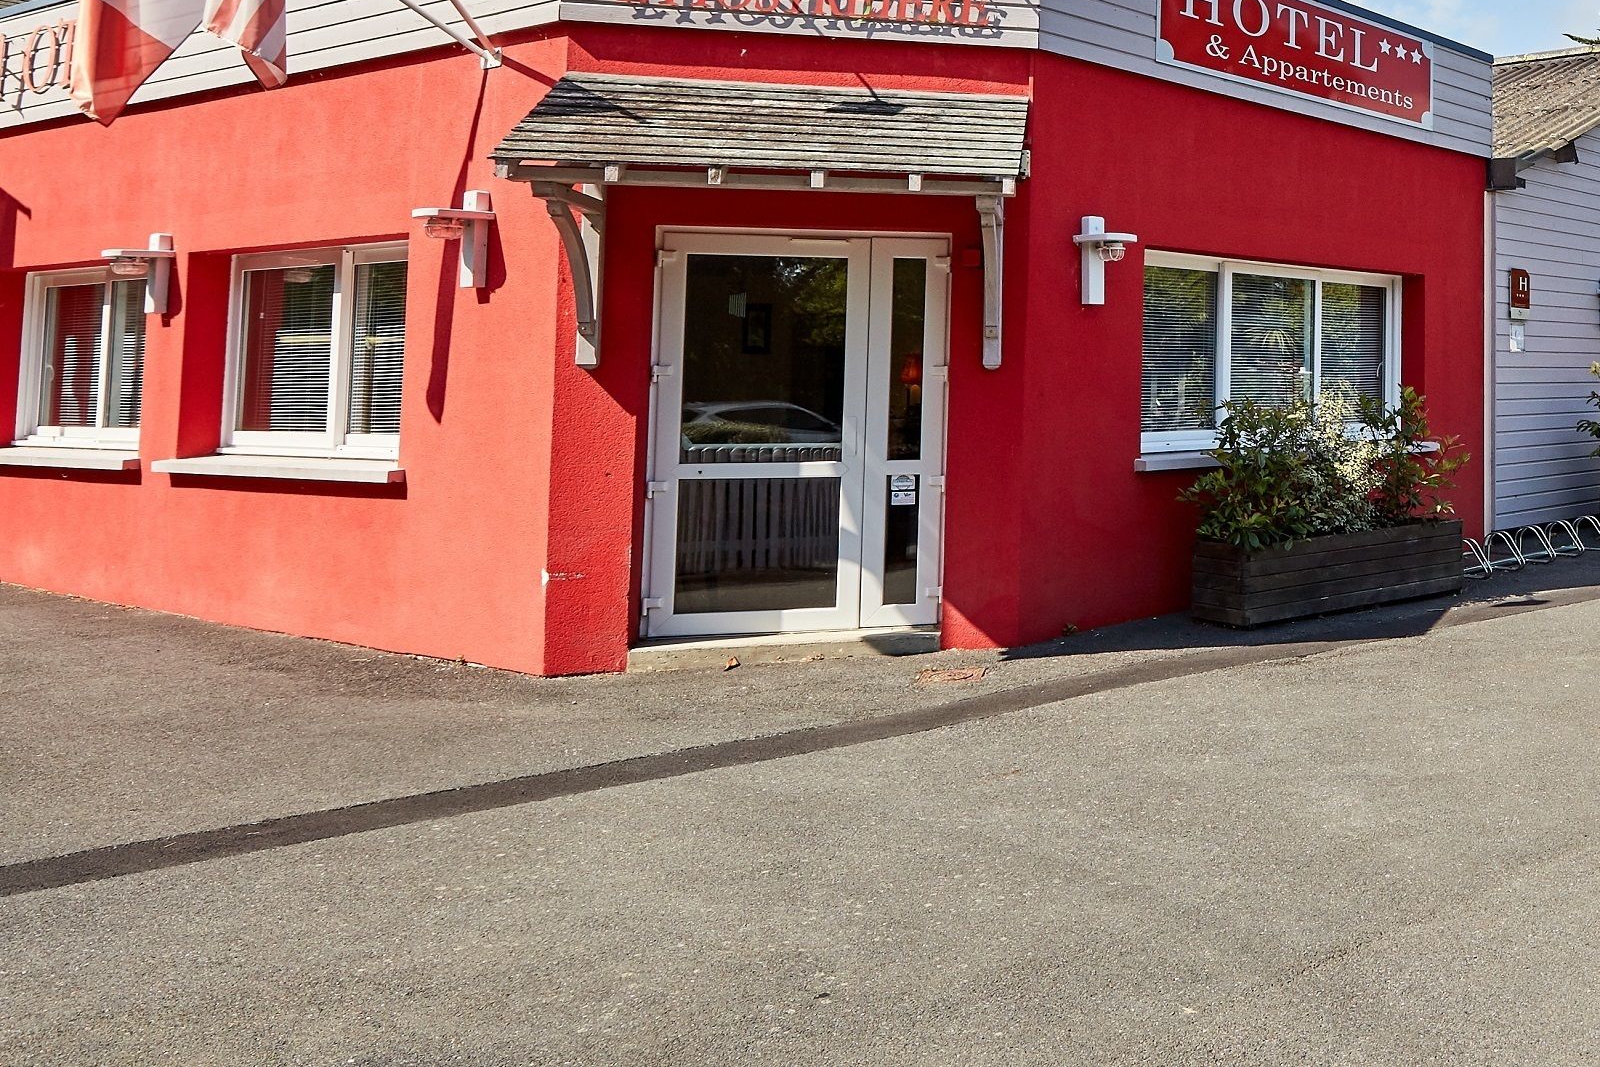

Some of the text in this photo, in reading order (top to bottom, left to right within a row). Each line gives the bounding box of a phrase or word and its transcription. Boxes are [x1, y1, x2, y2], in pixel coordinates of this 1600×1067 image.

[1205, 34, 1414, 109] & Appartements
[1519, 276, 1528, 292] H
